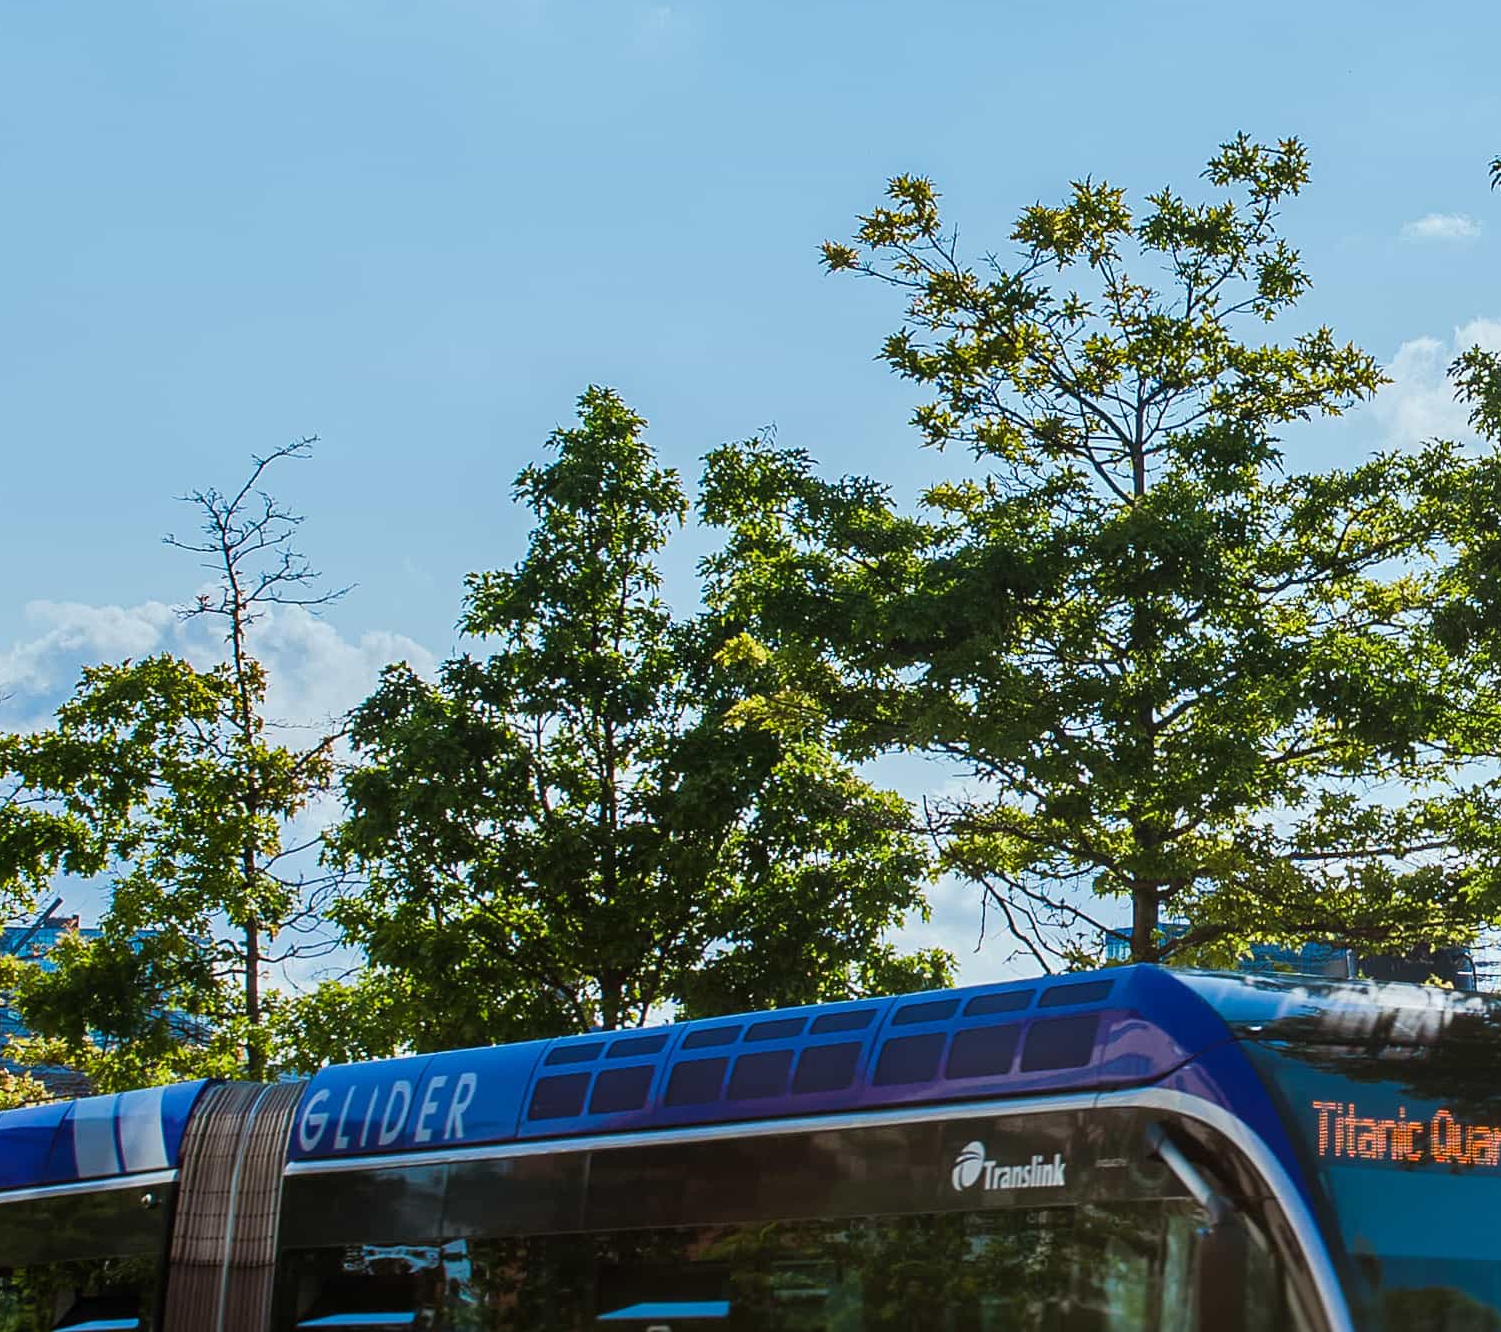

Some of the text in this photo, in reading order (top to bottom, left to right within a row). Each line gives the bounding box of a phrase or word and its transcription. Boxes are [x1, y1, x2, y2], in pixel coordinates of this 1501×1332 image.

[300, 1072, 478, 1152] GLIDER
[1312, 1100, 1424, 1161] Titanic
[984, 1153, 1067, 1191] Translink
